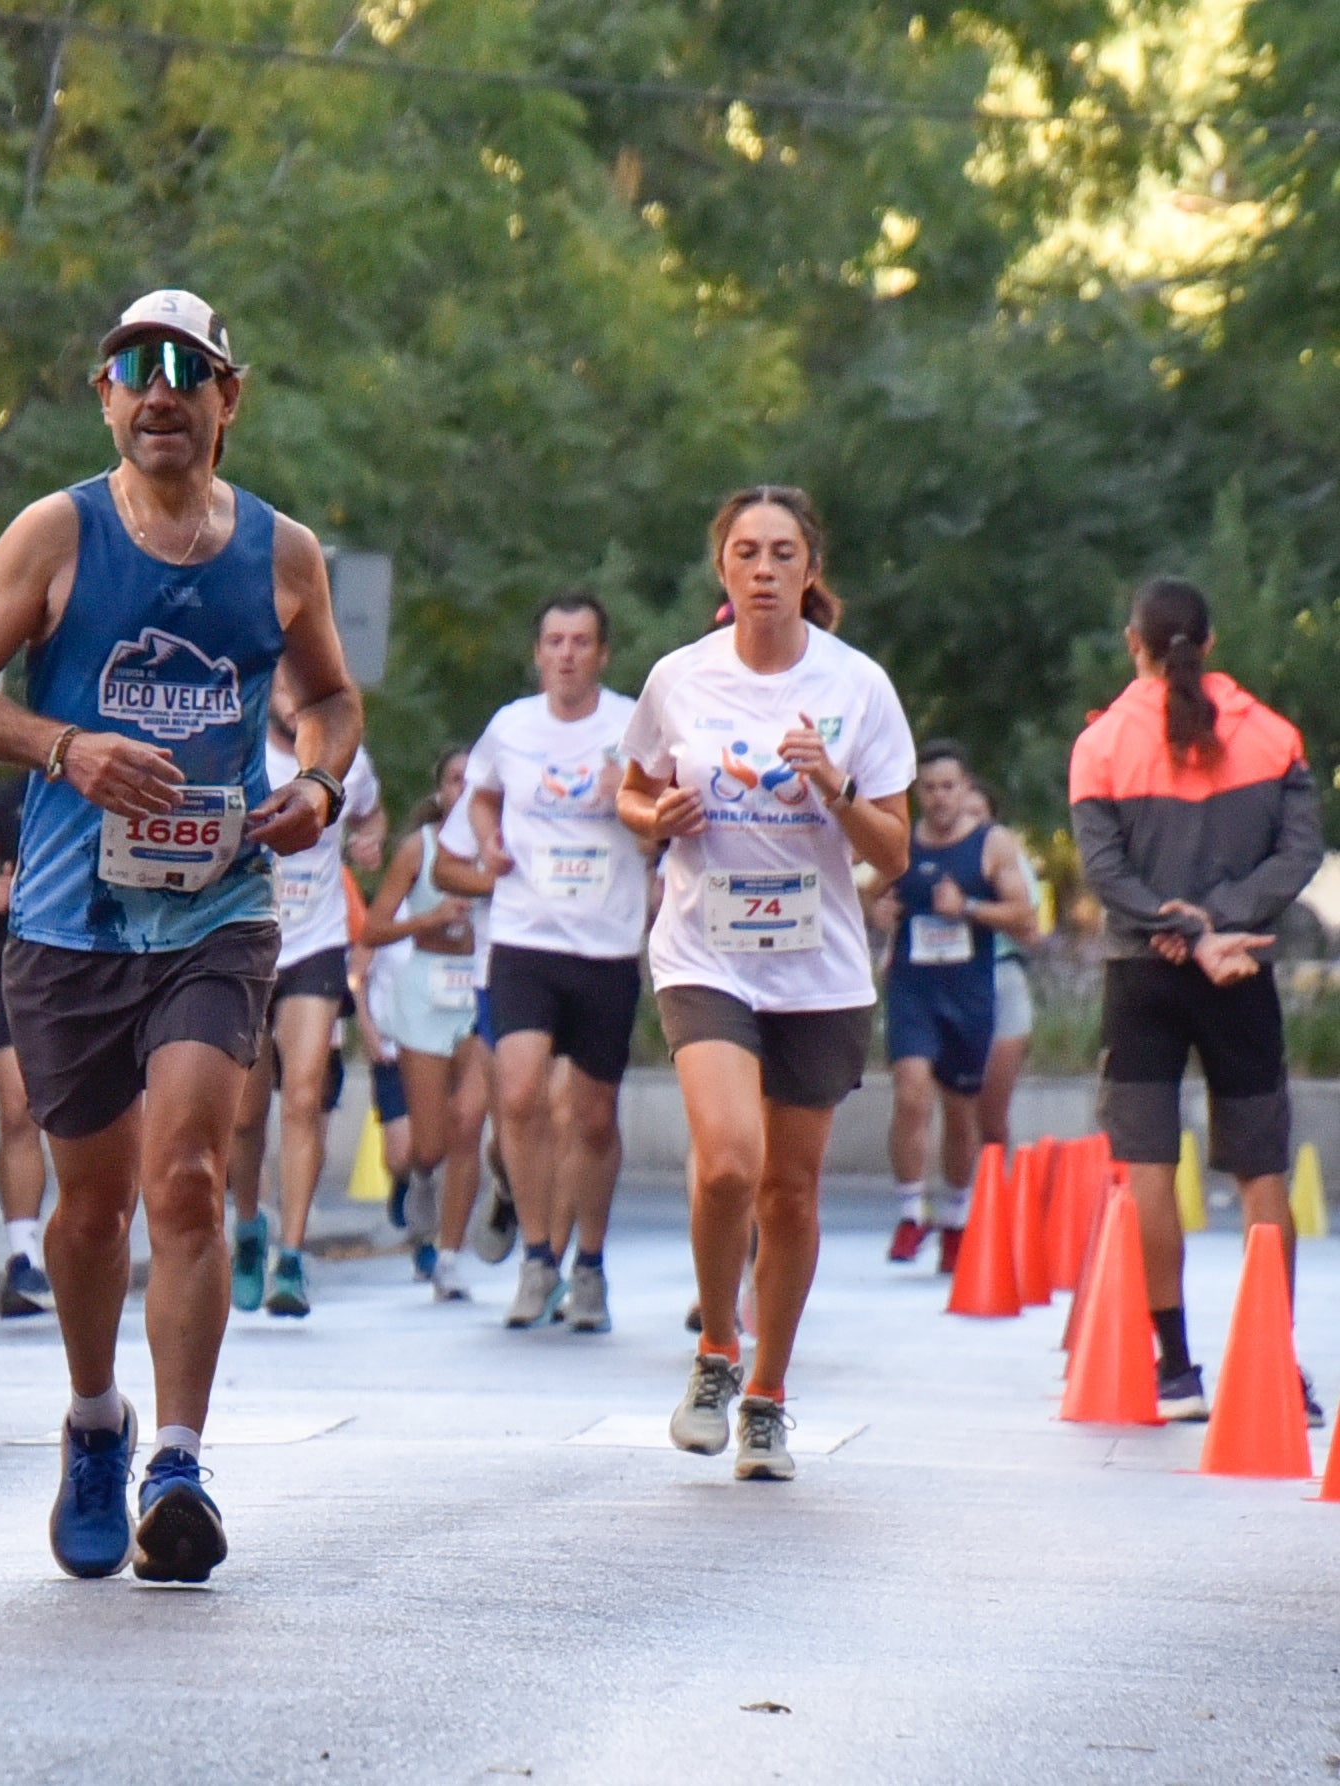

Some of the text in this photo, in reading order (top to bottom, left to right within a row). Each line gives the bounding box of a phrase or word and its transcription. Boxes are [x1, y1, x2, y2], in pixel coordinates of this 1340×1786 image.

[103, 681, 237, 712] PICO VELETA
[125, 817, 221, 846] 1686
[743, 897, 782, 918] 74
